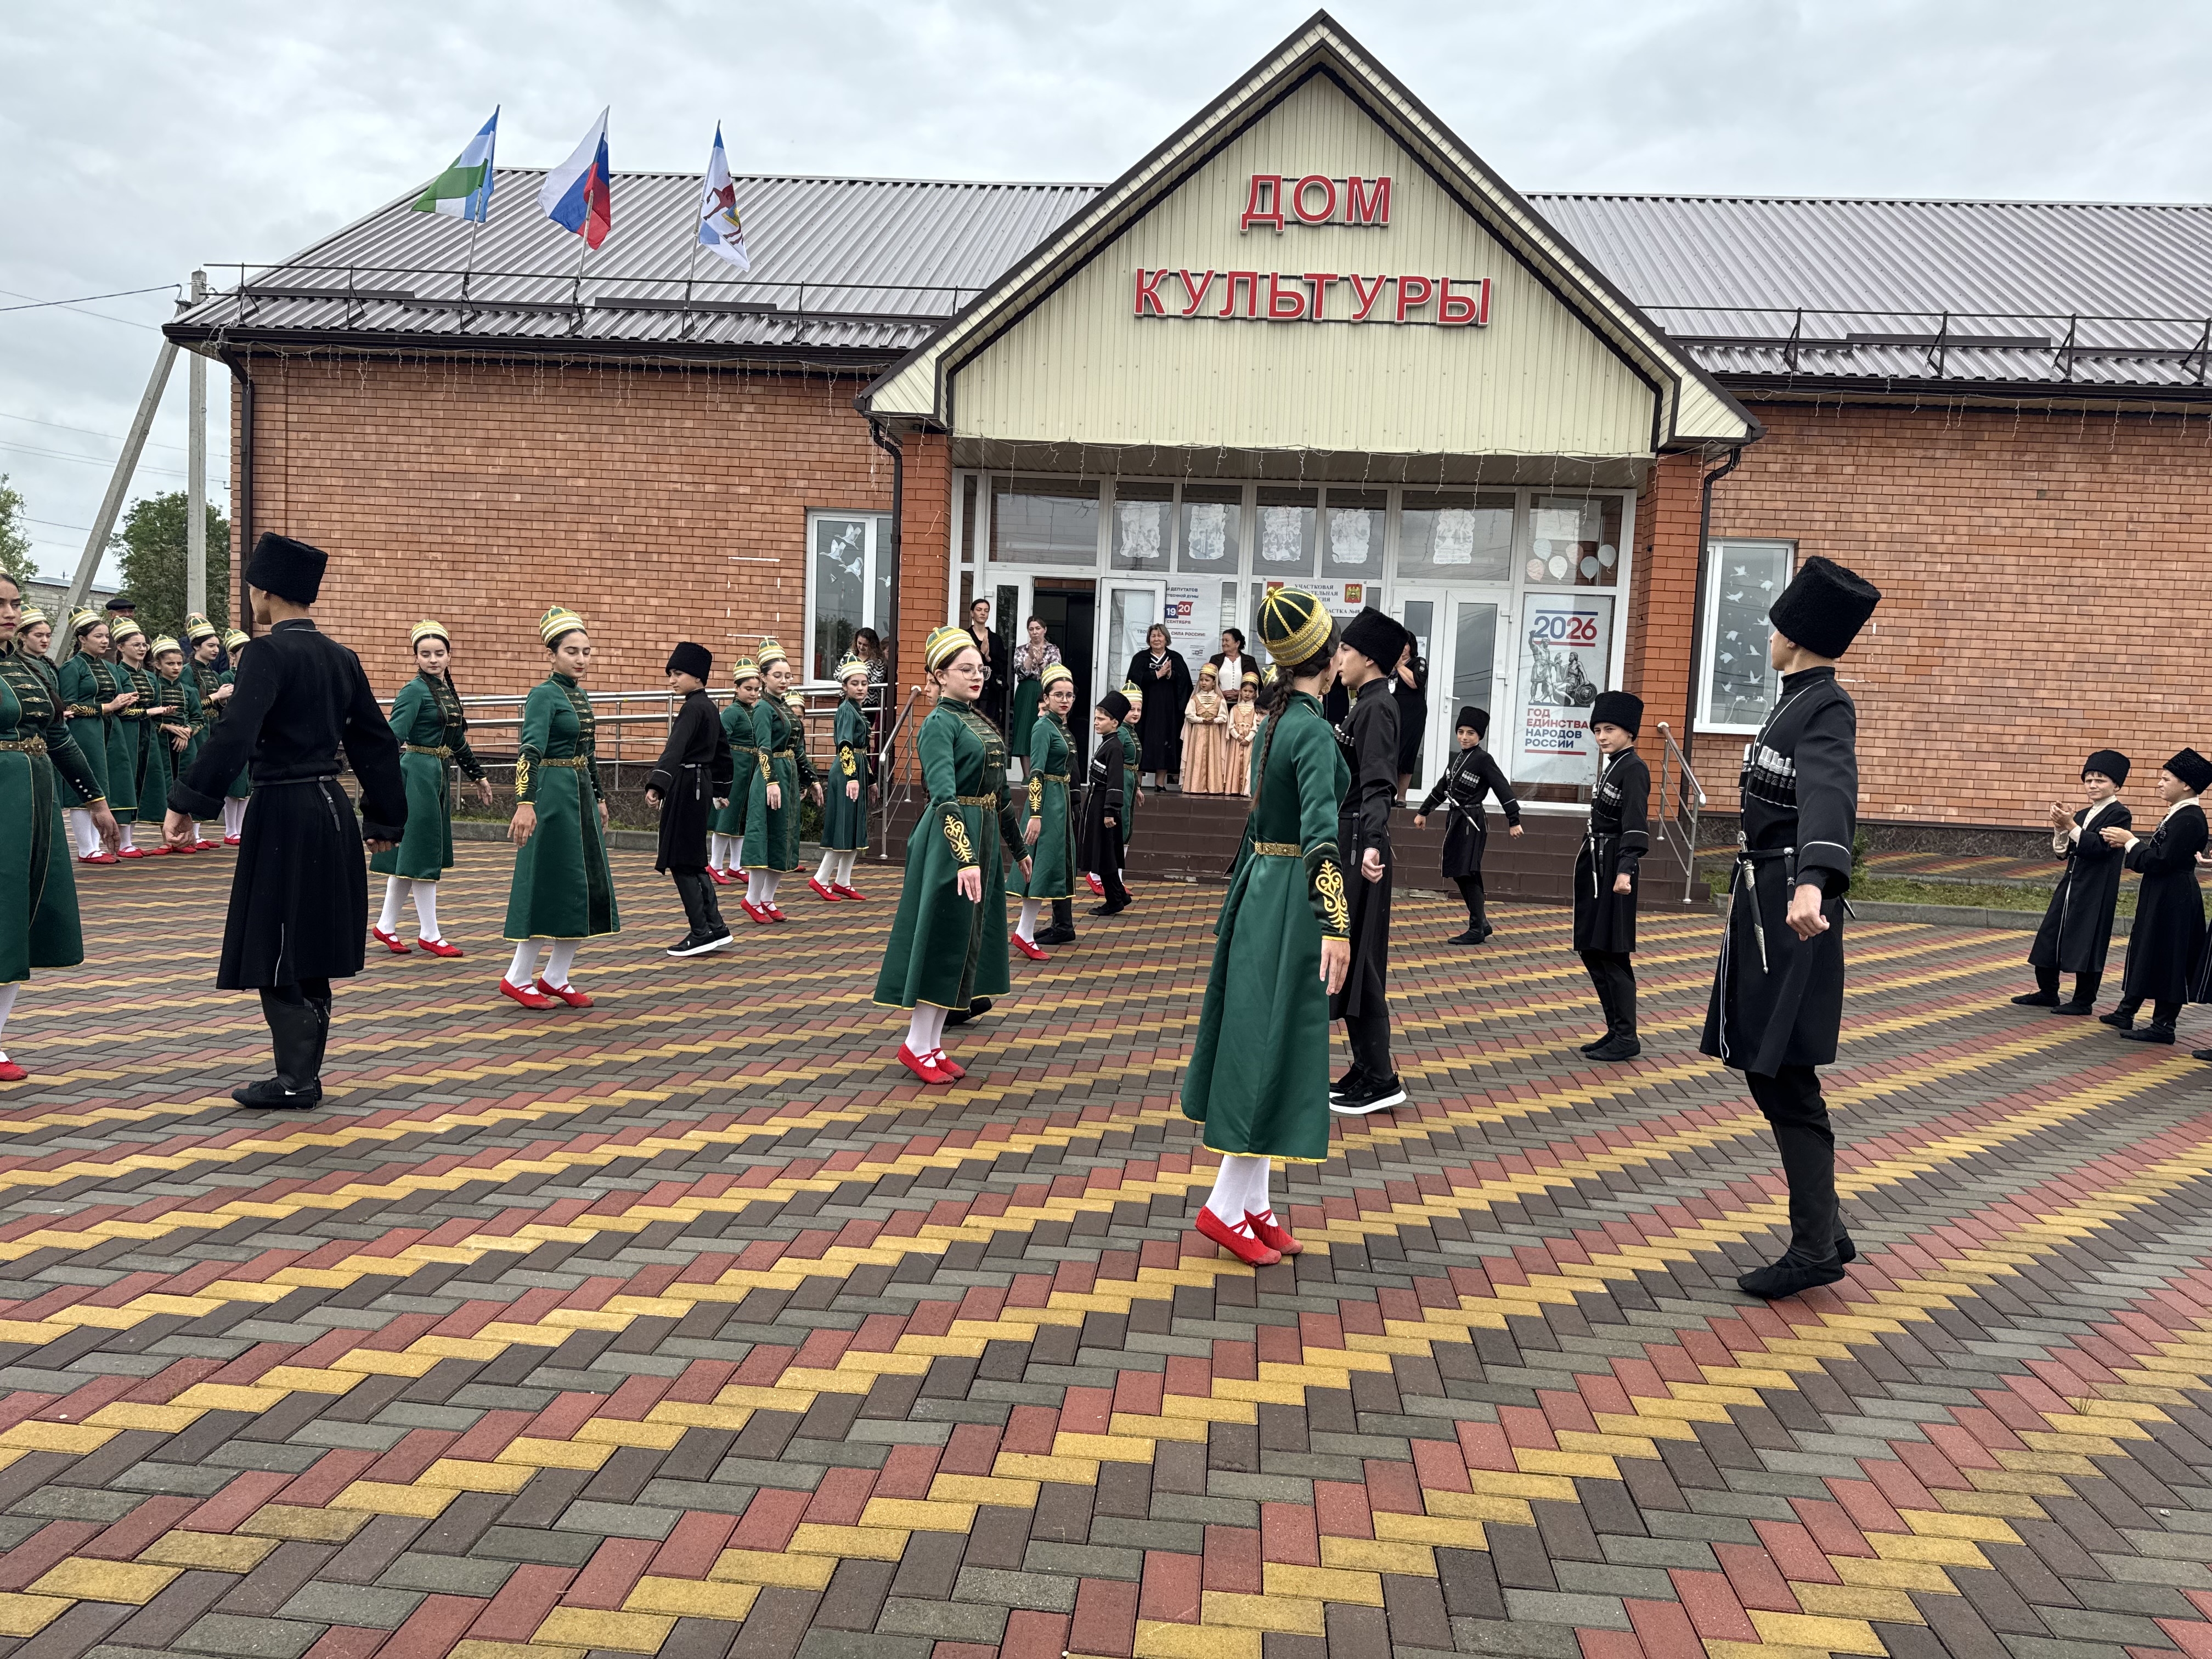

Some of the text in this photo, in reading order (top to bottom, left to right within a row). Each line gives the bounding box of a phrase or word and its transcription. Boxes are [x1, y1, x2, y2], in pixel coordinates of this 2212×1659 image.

[1240, 173, 1392, 234] ДОМ
[1134, 267, 1491, 326] КУЛЬТУРЫ
[1166, 604, 1190, 616] 19 20
[1534, 616, 1597, 640] 2026
[1527, 708, 1550, 718] ГОД
[1526, 718, 1589, 729] ЕДИНСТВА
[1526, 728, 1582, 739] НАРОДОВ
[1525, 738, 1574, 748] РОССИИ
